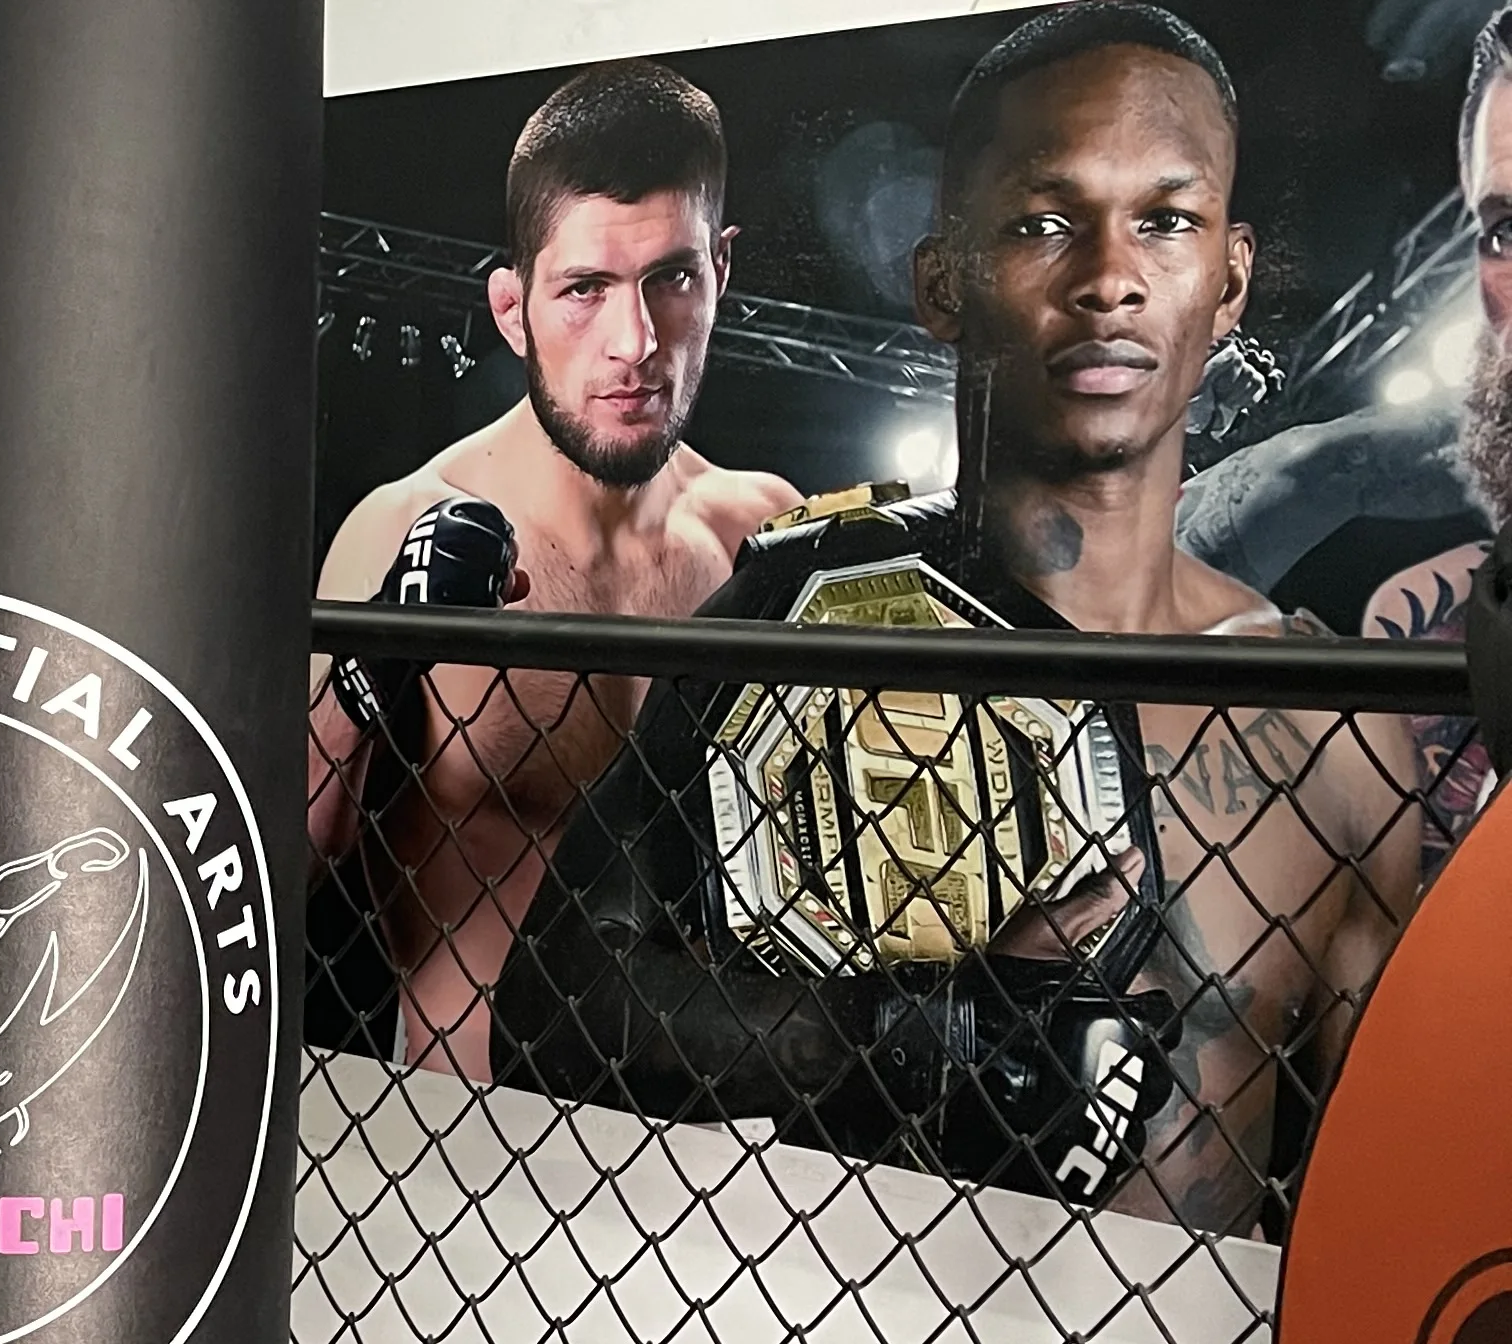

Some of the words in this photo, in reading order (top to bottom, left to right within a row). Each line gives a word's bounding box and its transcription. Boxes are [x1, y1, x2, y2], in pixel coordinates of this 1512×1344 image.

[398, 511, 439, 605] UFC
[162, 792, 261, 1015] ARTS
[1055, 1039, 1144, 1196] UFC
